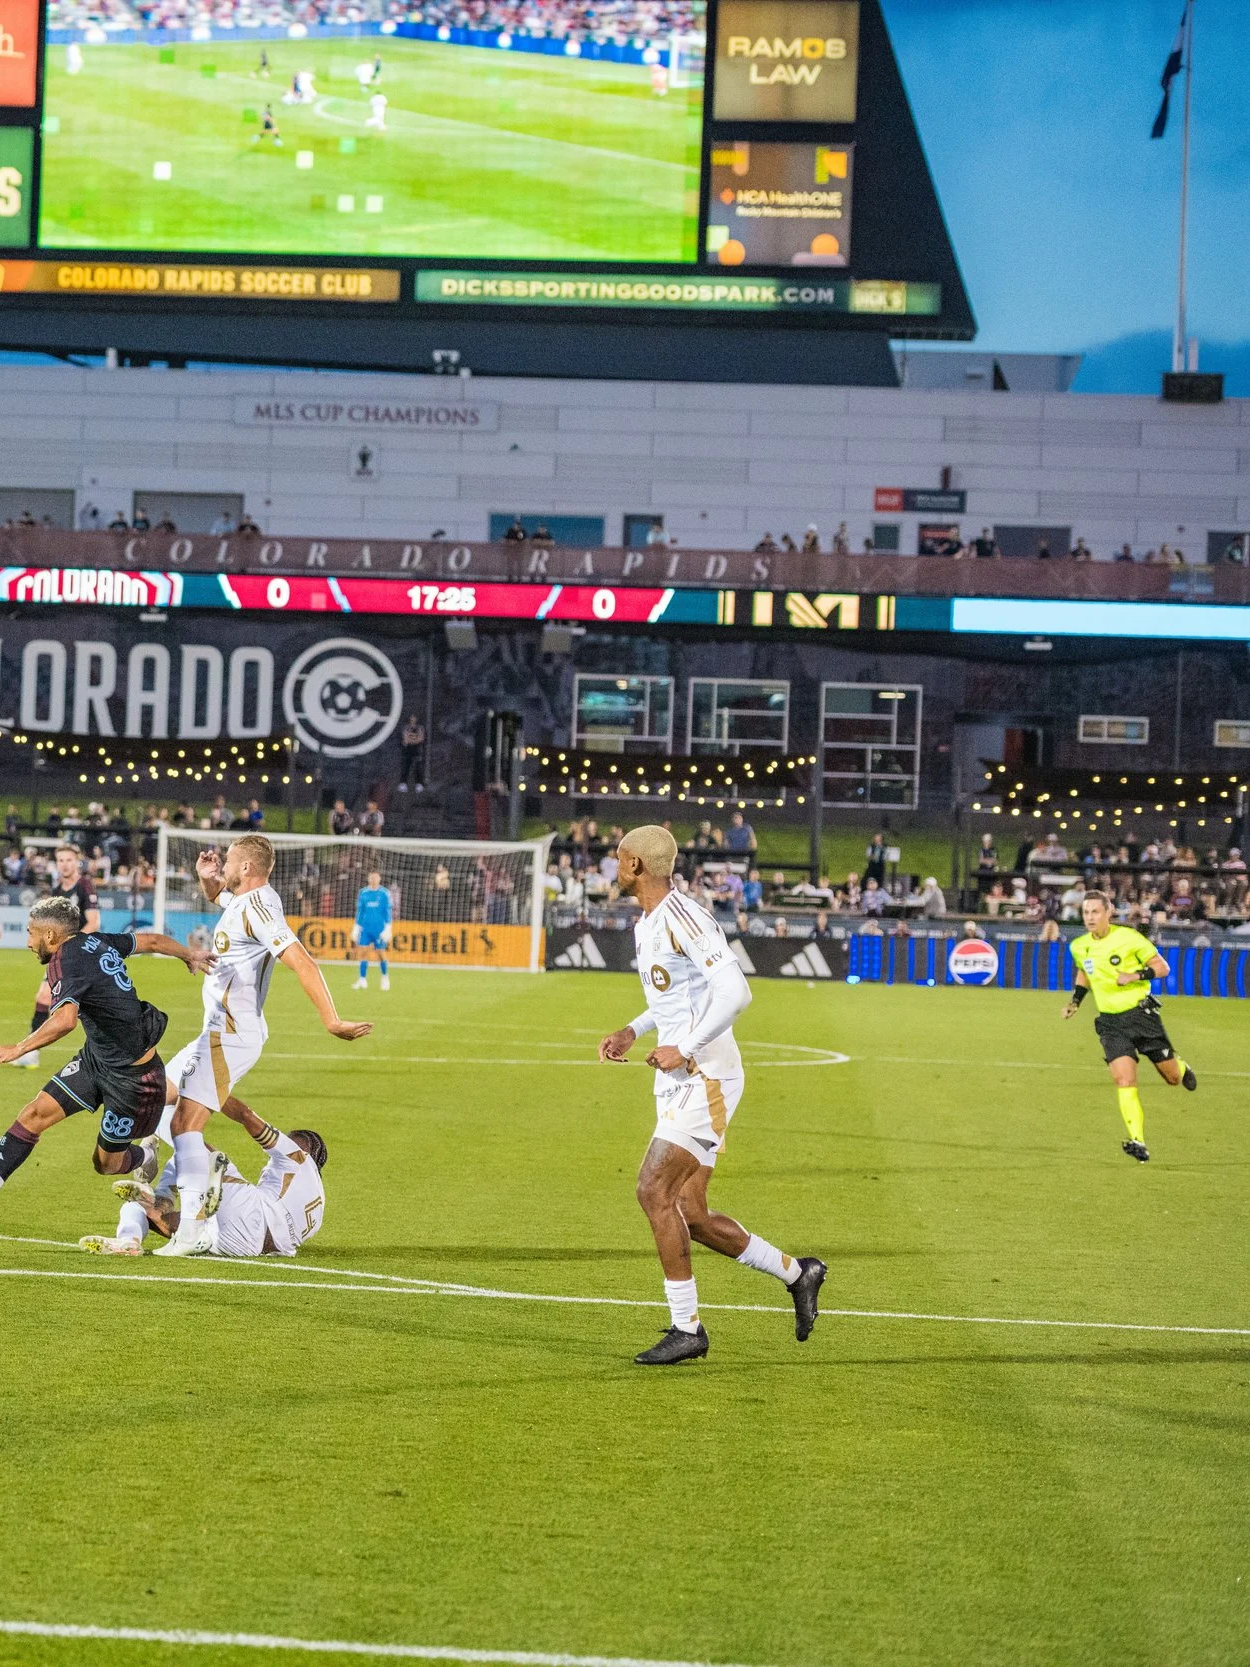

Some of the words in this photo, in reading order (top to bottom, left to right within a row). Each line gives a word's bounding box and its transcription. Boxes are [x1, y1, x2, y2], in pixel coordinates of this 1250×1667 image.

[728, 36, 846, 59] RAMOS
[750, 63, 822, 86] LAW
[58, 266, 159, 289] COLORADO
[163, 269, 236, 292] RAPIDS
[240, 271, 316, 295] SOCCER
[320, 274, 372, 296] CLUB
[440, 277, 834, 305] DICKSSPORTINGGOODSPARK.COM
[253, 403, 295, 421] MLS
[299, 405, 344, 422] CUP
[347, 405, 481, 426] CHAMPIONS
[125, 538, 472, 570] COLORADO
[527, 549, 773, 581] RAPIDS
[267, 577, 291, 608] 0
[406, 585, 476, 611] 17:25
[592, 588, 616, 619] 0
[297, 920, 468, 956] Conental
[713, 950, 723, 962] tv
[954, 958, 995, 968] PEPSI
[102, 1110, 134, 1136] 88
